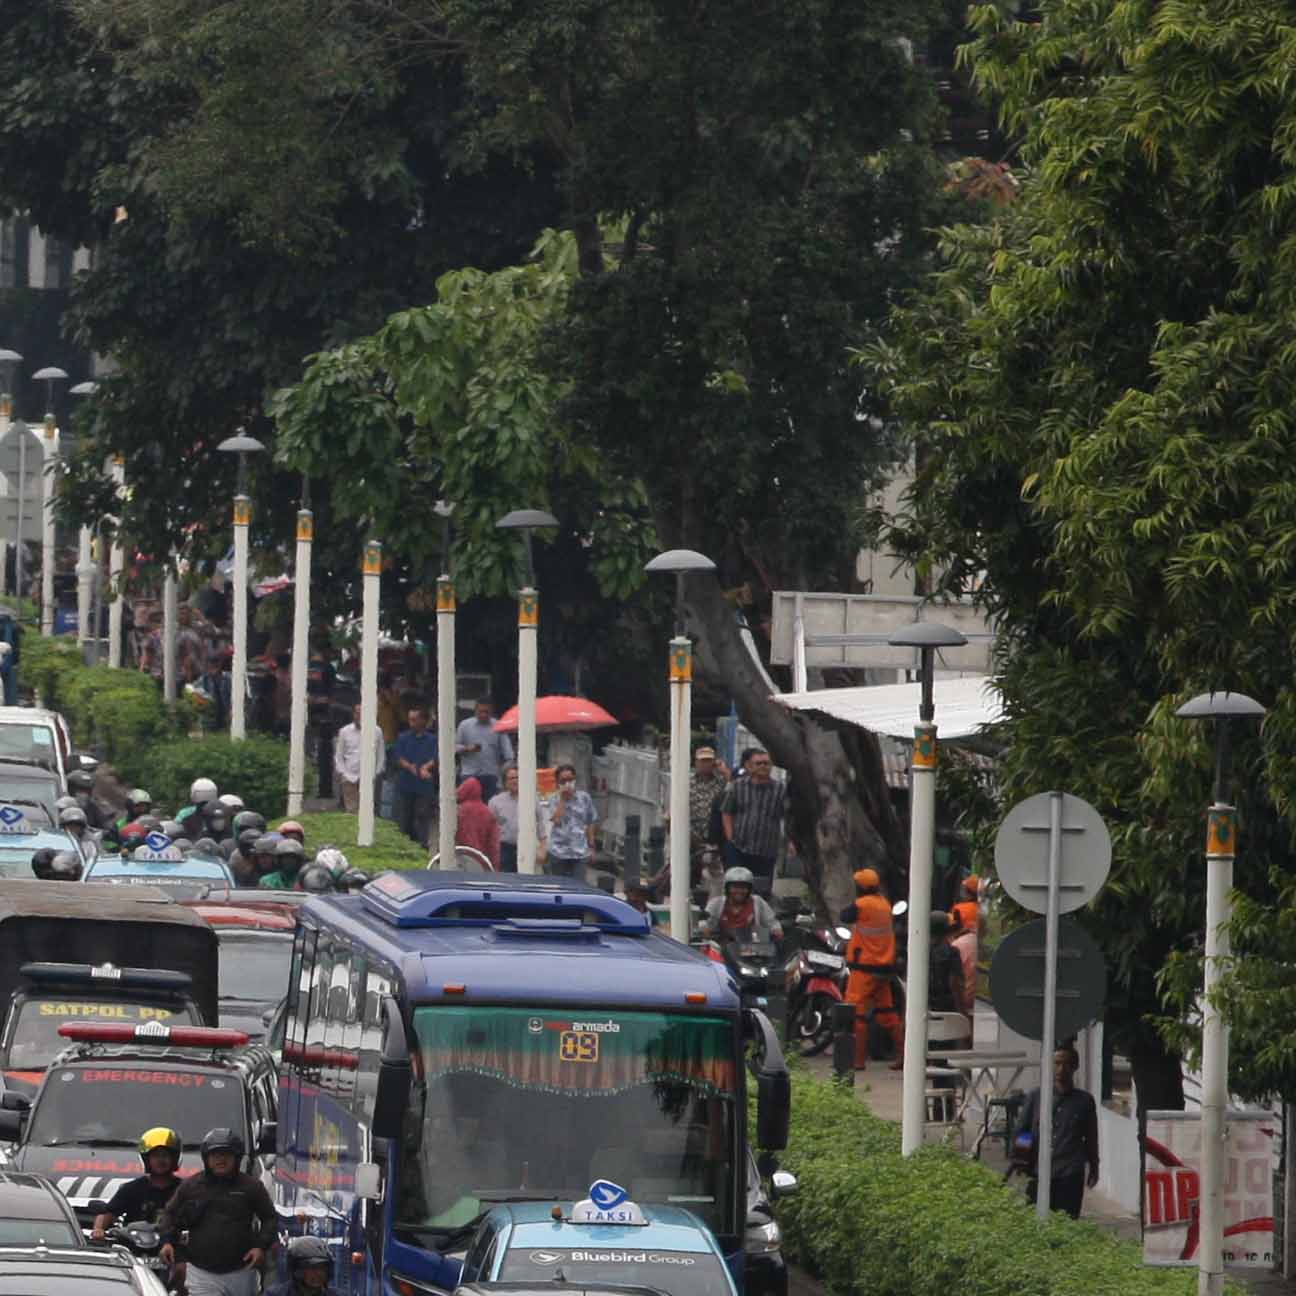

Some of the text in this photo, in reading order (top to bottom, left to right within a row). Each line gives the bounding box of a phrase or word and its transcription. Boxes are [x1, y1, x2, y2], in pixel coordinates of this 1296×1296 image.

[38, 1003, 171, 1020] SATPOL PP
[572, 1019, 621, 1033] armada
[82, 1070, 205, 1087] EMERGENCY
[586, 1211, 633, 1222] TAKSI
[572, 1252, 695, 1266] Bluebird Group
